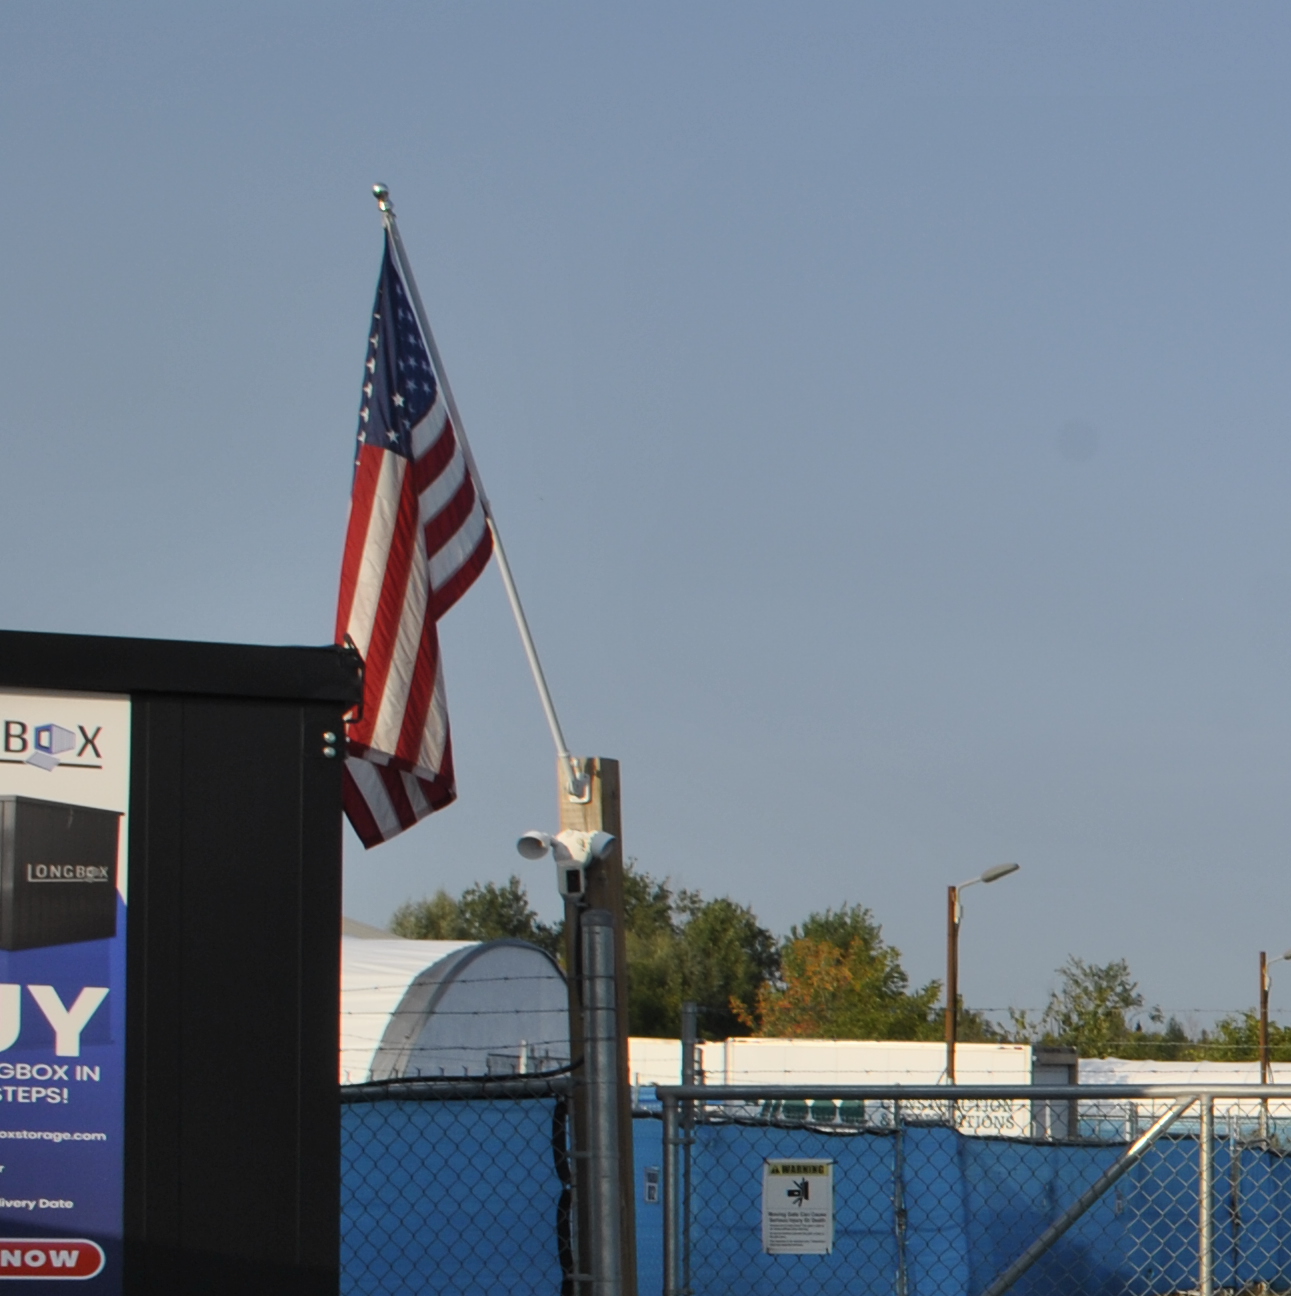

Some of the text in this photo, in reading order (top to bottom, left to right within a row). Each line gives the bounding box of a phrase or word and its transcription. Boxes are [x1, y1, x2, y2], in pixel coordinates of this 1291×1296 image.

[0, 1063, 100, 1081] GBOX IN
[0, 1086, 68, 1103] TEPS!
[781, 1165, 825, 1174] WARNING
[39, 1198, 74, 1209] Date
[0, 1249, 79, 1268] NOW
